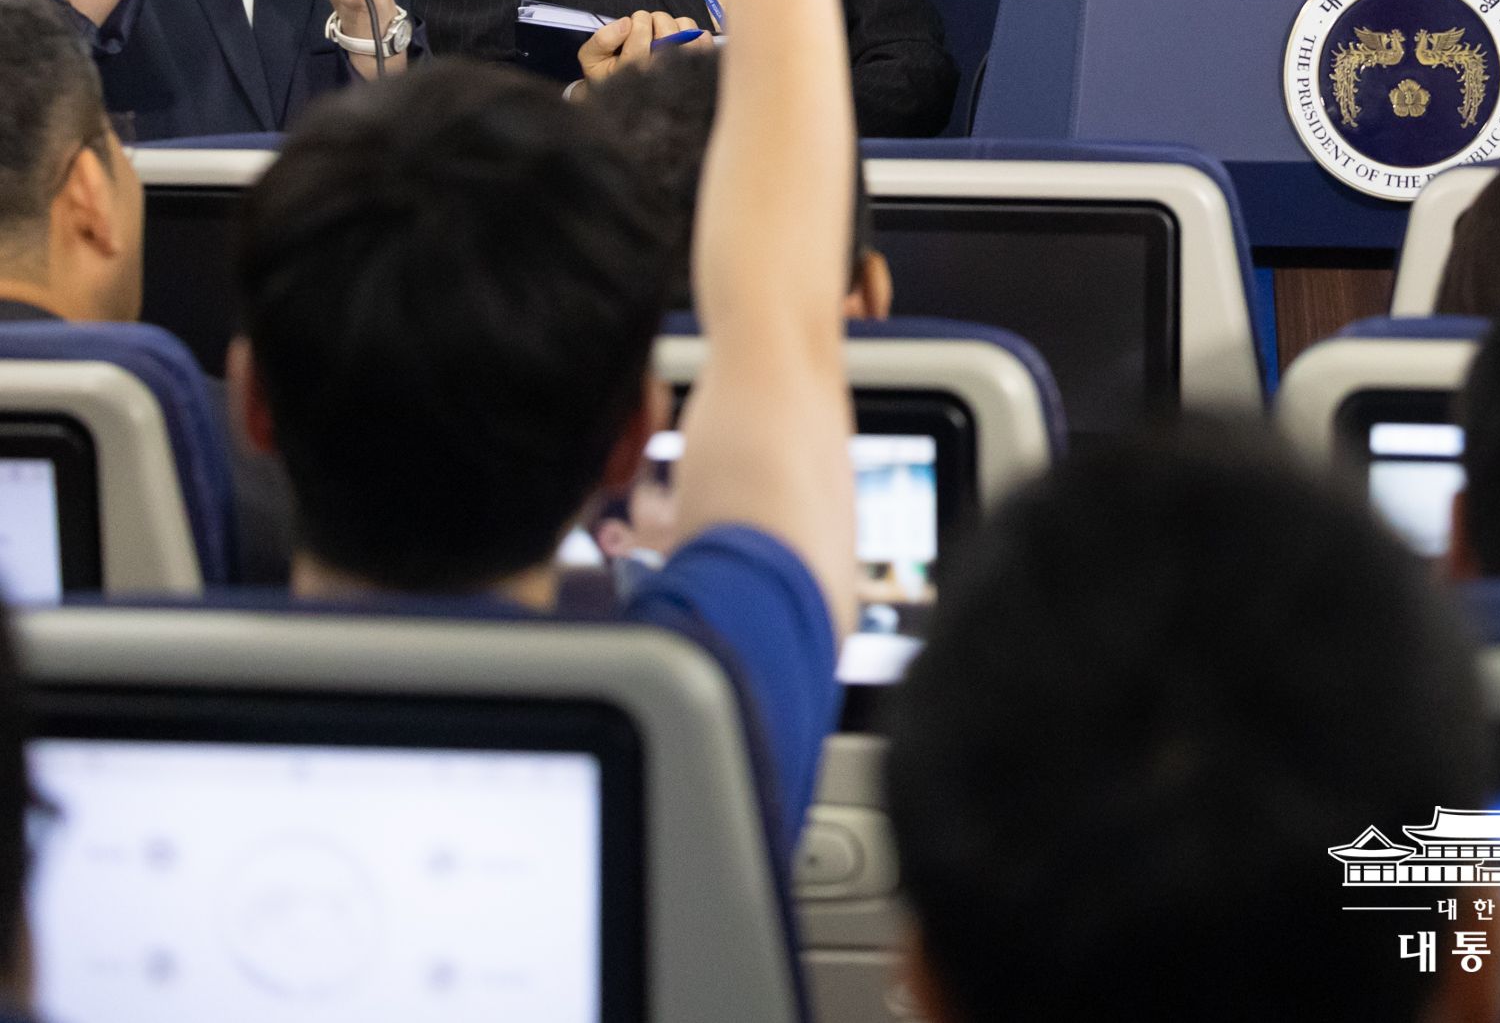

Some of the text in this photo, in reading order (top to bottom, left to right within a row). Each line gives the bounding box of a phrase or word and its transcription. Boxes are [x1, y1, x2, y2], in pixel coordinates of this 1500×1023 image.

[1297, 35, 1317, 71] THE
[1297, 77, 1356, 167] PRESIDENT
[1355, 164, 1380, 181] OF
[1384, 172, 1422, 188] THE
